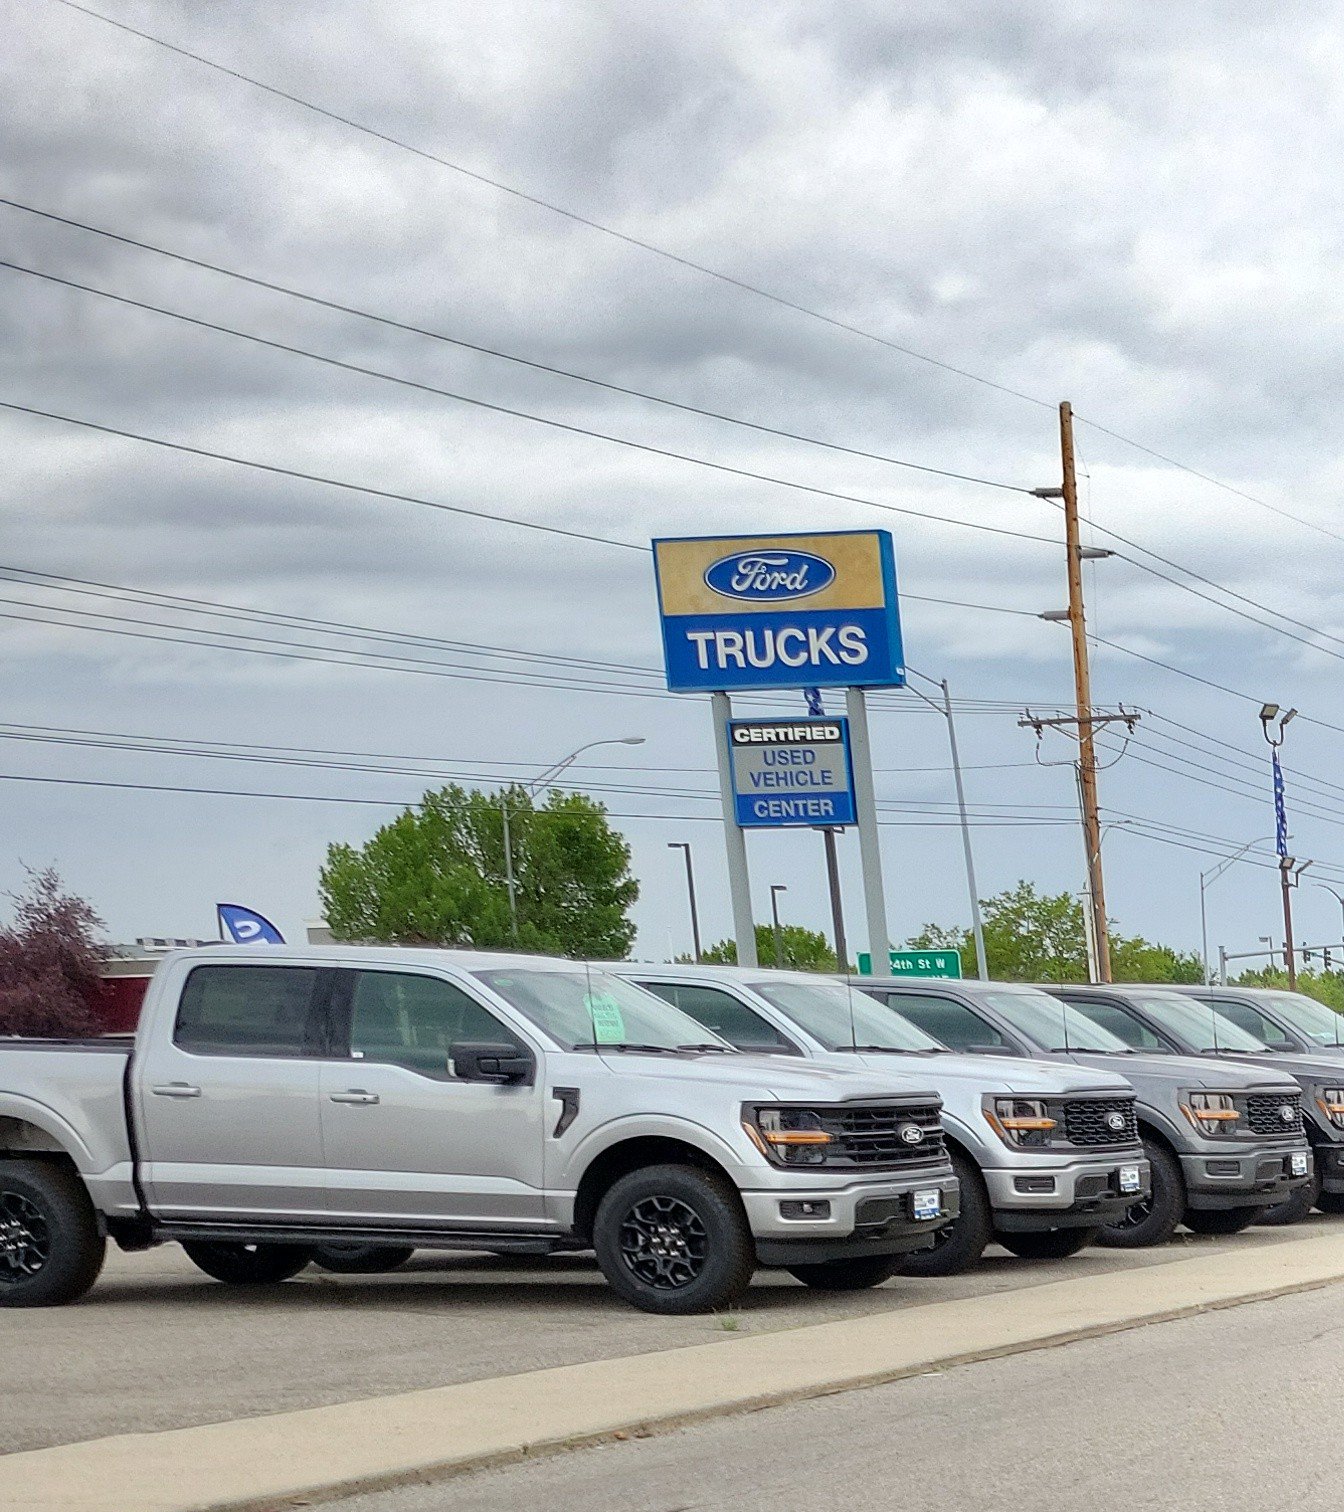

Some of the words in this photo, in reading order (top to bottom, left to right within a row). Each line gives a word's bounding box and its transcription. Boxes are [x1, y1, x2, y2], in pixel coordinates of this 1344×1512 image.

[731, 557, 809, 592] Ford
[687, 625, 869, 669] TRUCKS
[734, 726, 840, 743] CERTIFIED
[763, 749, 816, 766] USED
[749, 769, 834, 788] VEHICLE
[754, 799, 835, 818] CENTER
[917, 958, 932, 970] St
[935, 958, 946, 969] W
